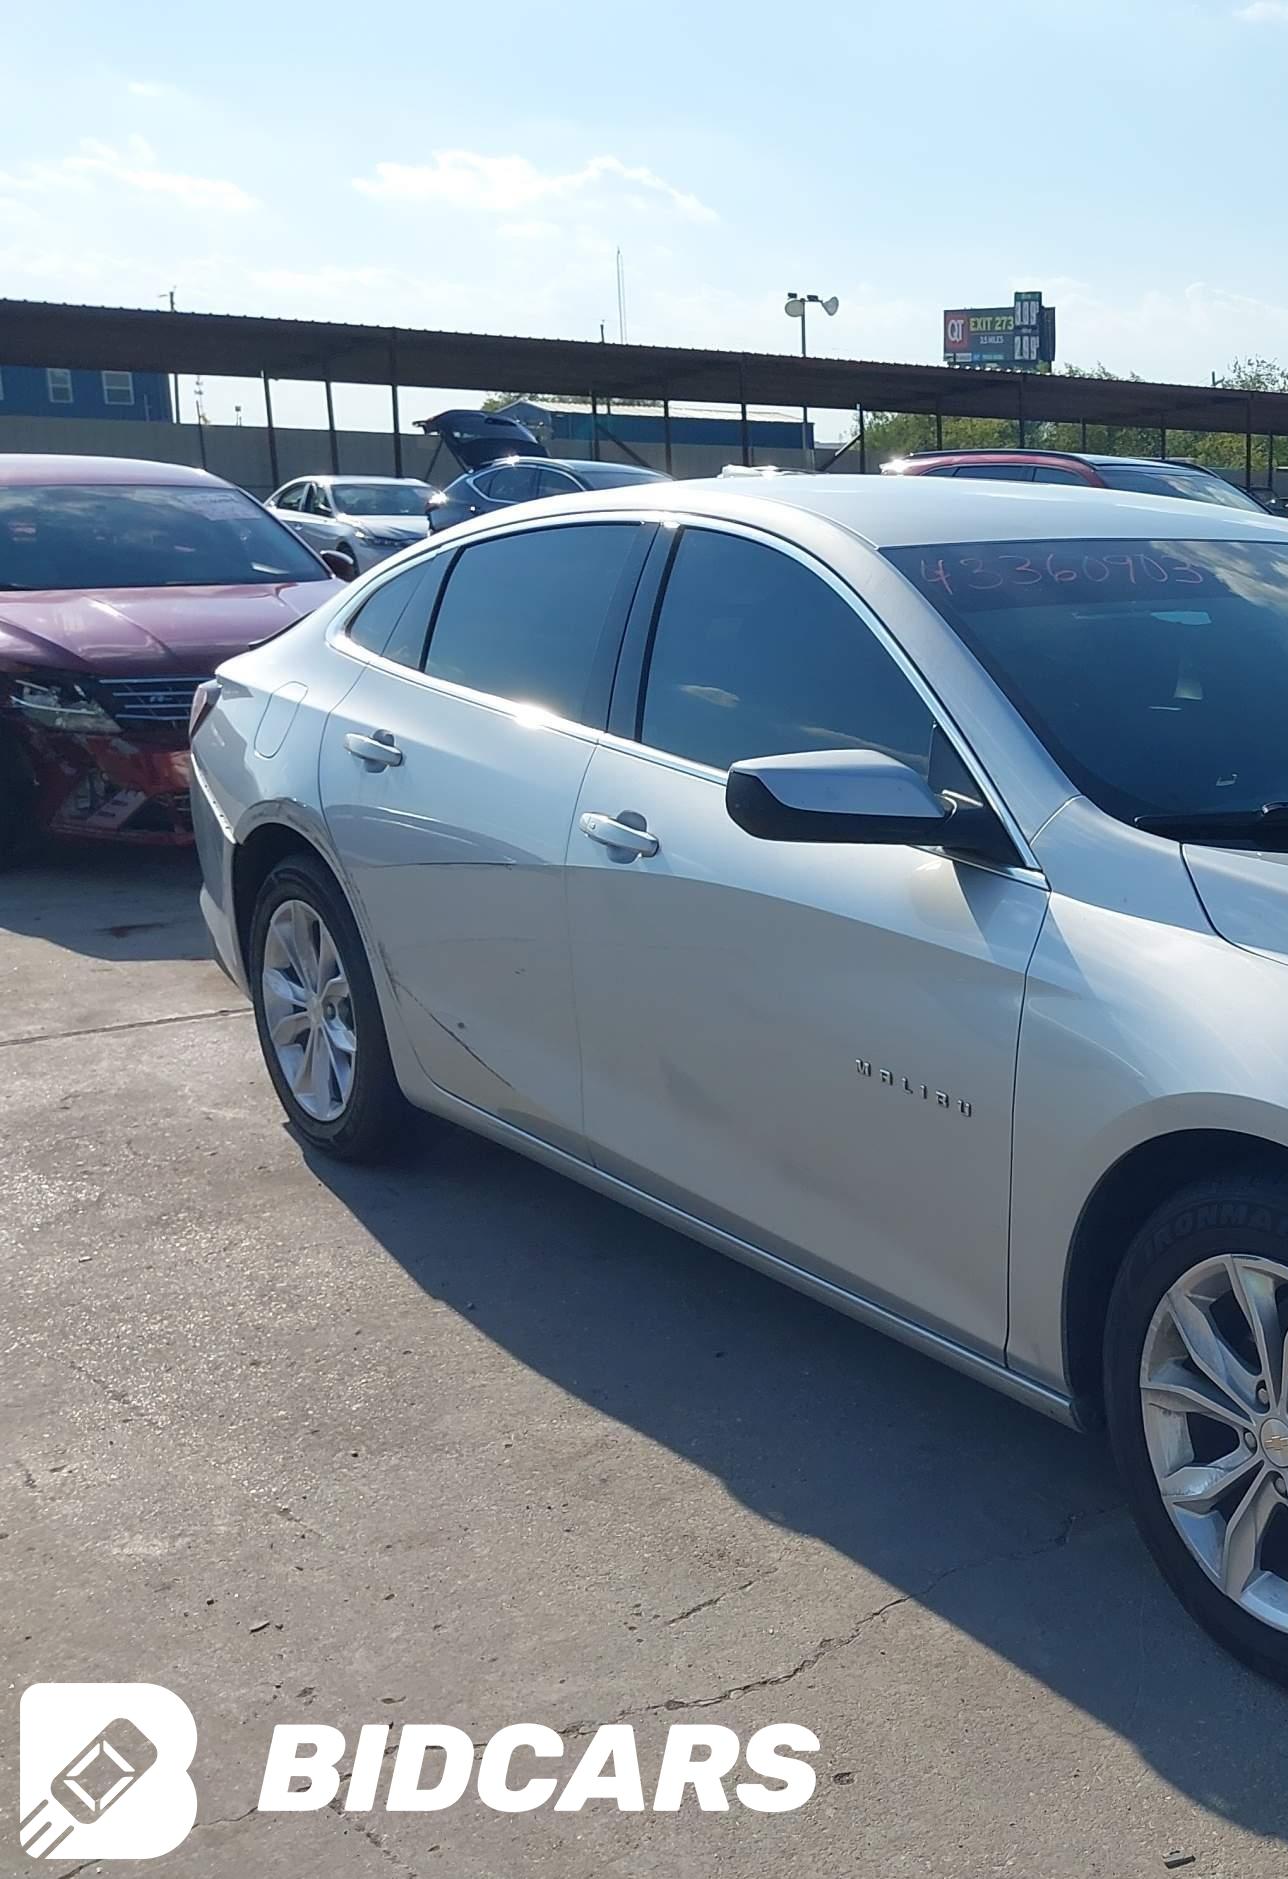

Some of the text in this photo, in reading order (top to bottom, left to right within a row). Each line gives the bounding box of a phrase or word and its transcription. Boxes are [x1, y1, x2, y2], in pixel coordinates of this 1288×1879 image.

[947, 319, 964, 343] QT
[970, 316, 1014, 331] EXIT 273
[919, 553, 1205, 595] 43360903
[855, 1058, 972, 1117] MALIBU
